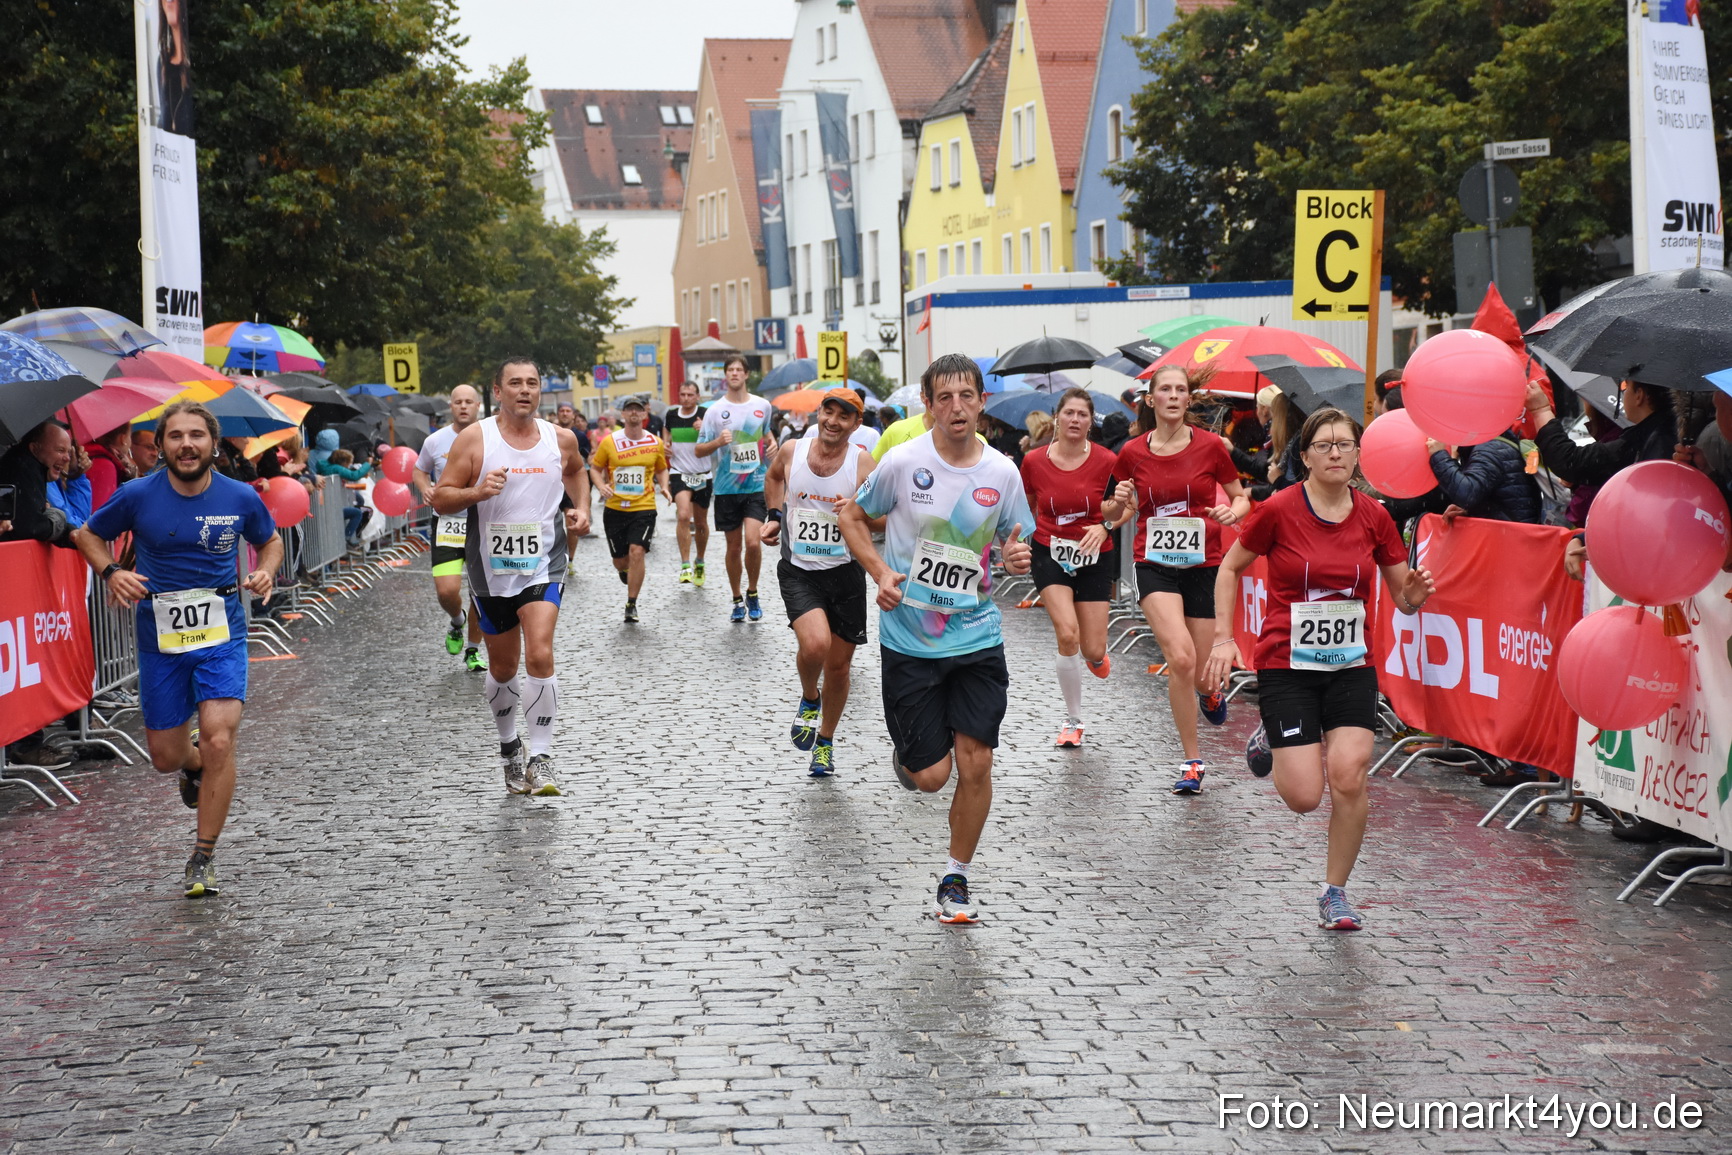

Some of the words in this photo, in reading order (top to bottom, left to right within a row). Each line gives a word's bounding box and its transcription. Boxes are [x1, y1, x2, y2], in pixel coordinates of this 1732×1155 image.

[1497, 146, 1520, 156] Ulmer
[1522, 143, 1547, 153] Gasse
[1307, 196, 1374, 219] Block
[943, 214, 963, 236] HOTEL
[1315, 229, 1360, 293] C
[820, 333, 844, 343] Block
[387, 346, 413, 356] Block
[826, 347, 840, 370] D
[393, 359, 411, 383] D
[617, 451, 638, 461] MAX
[734, 450, 757, 461] 2448
[616, 473, 642, 485] 2813
[809, 494, 840, 503] KLEB
[911, 491, 934, 501] PARTL
[976, 491, 998, 502] Hervis
[798, 521, 842, 543] 2315
[492, 535, 539, 555] 2415
[1152, 530, 1200, 550] 2324
[805, 546, 831, 555] Roland
[1162, 554, 1189, 563] Marina
[917, 557, 979, 590] 2067
[929, 593, 954, 606] Hans
[1327, 603, 1360, 613] BOCK
[169, 602, 211, 630] 207
[181, 633, 207, 643] Frank
[1300, 618, 1358, 646] 2581
[1314, 652, 1347, 662] Carina
